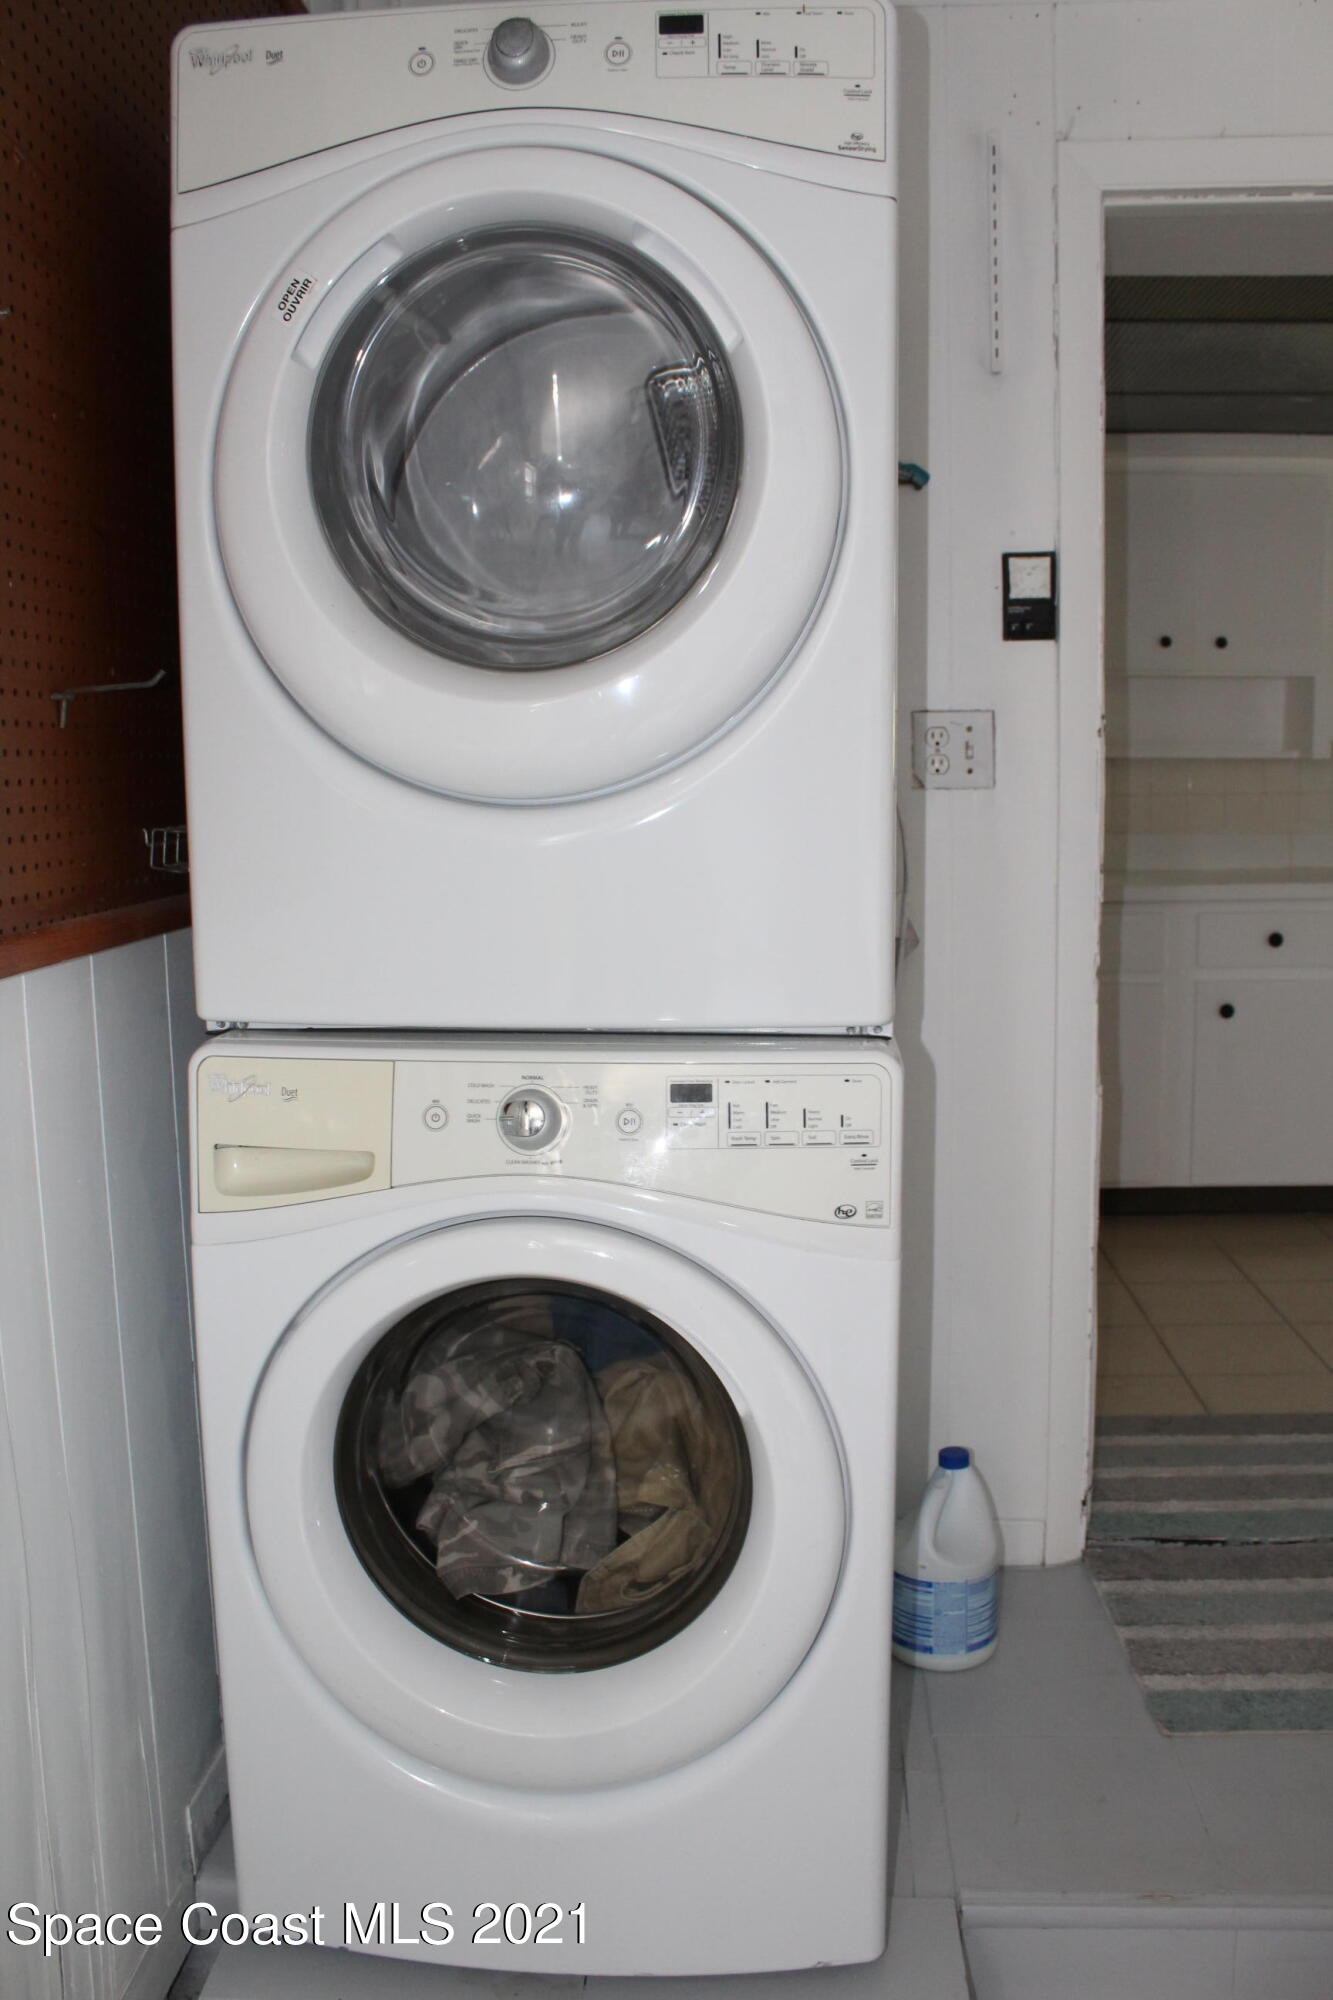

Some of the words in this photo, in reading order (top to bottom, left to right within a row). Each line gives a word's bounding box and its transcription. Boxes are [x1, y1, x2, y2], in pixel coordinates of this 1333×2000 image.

[265, 50, 284, 63] Duet
[278, 278, 300, 311] OPEN
[283, 278, 312, 322] OUVRIR
[281, 1086, 298, 1099] Duet
